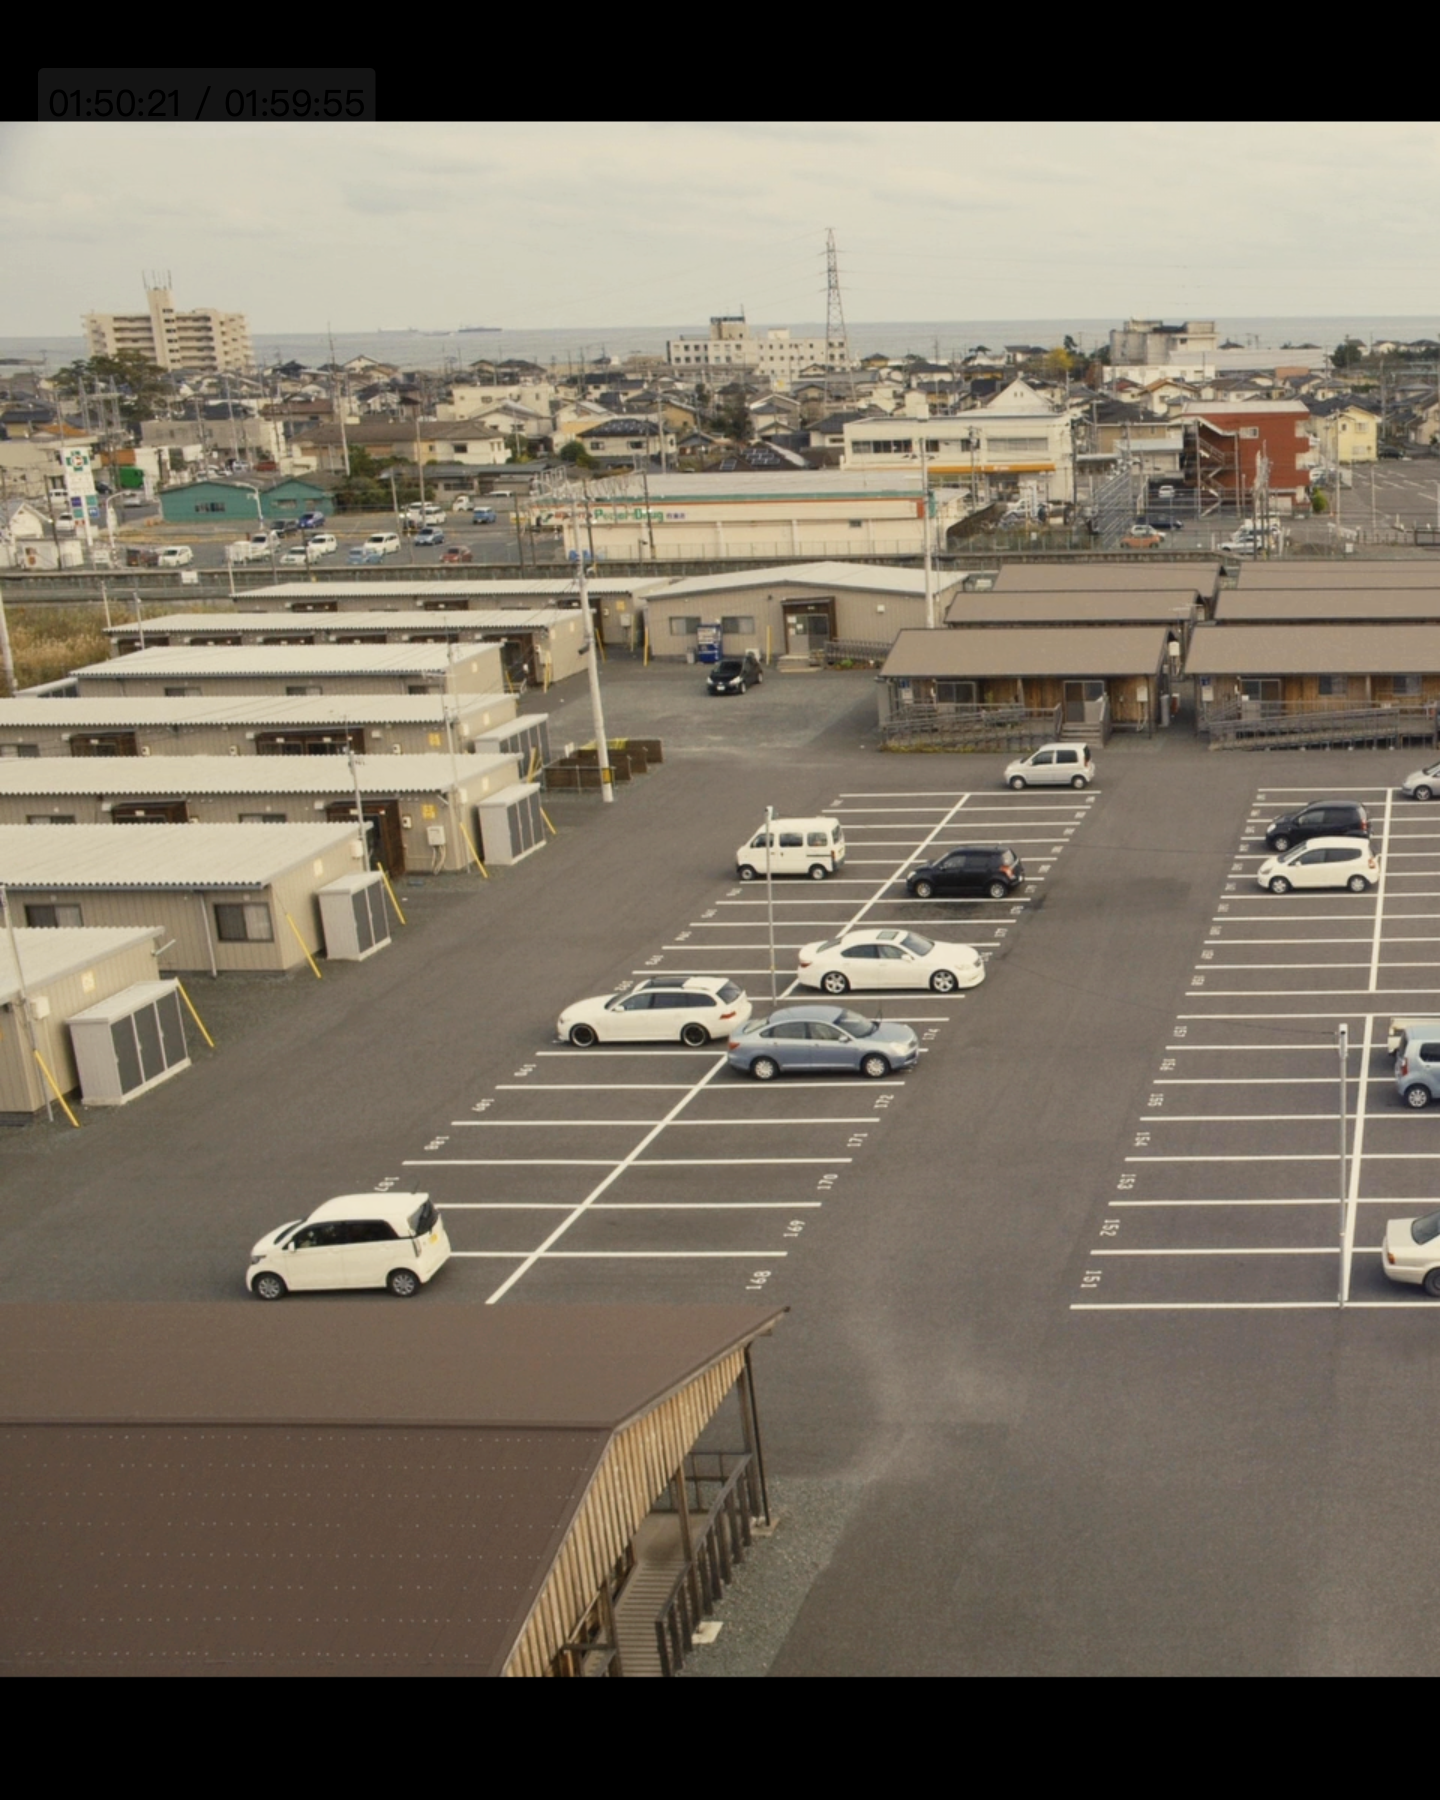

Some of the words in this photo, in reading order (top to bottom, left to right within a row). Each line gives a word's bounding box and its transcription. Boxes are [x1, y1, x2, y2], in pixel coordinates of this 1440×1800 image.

[873, 1093, 895, 1110] 172
[1146, 1092, 1165, 1108] 155
[846, 1132, 869, 1148] 171
[1133, 1131, 1152, 1148] 154
[374, 1176, 401, 1192] 187
[816, 1173, 839, 1191] 170
[1116, 1173, 1137, 1191] 153
[782, 1219, 806, 1238] 169
[1098, 1218, 1121, 1237] 152
[744, 1269, 773, 1291] 168
[1079, 1269, 1103, 1289] 151
